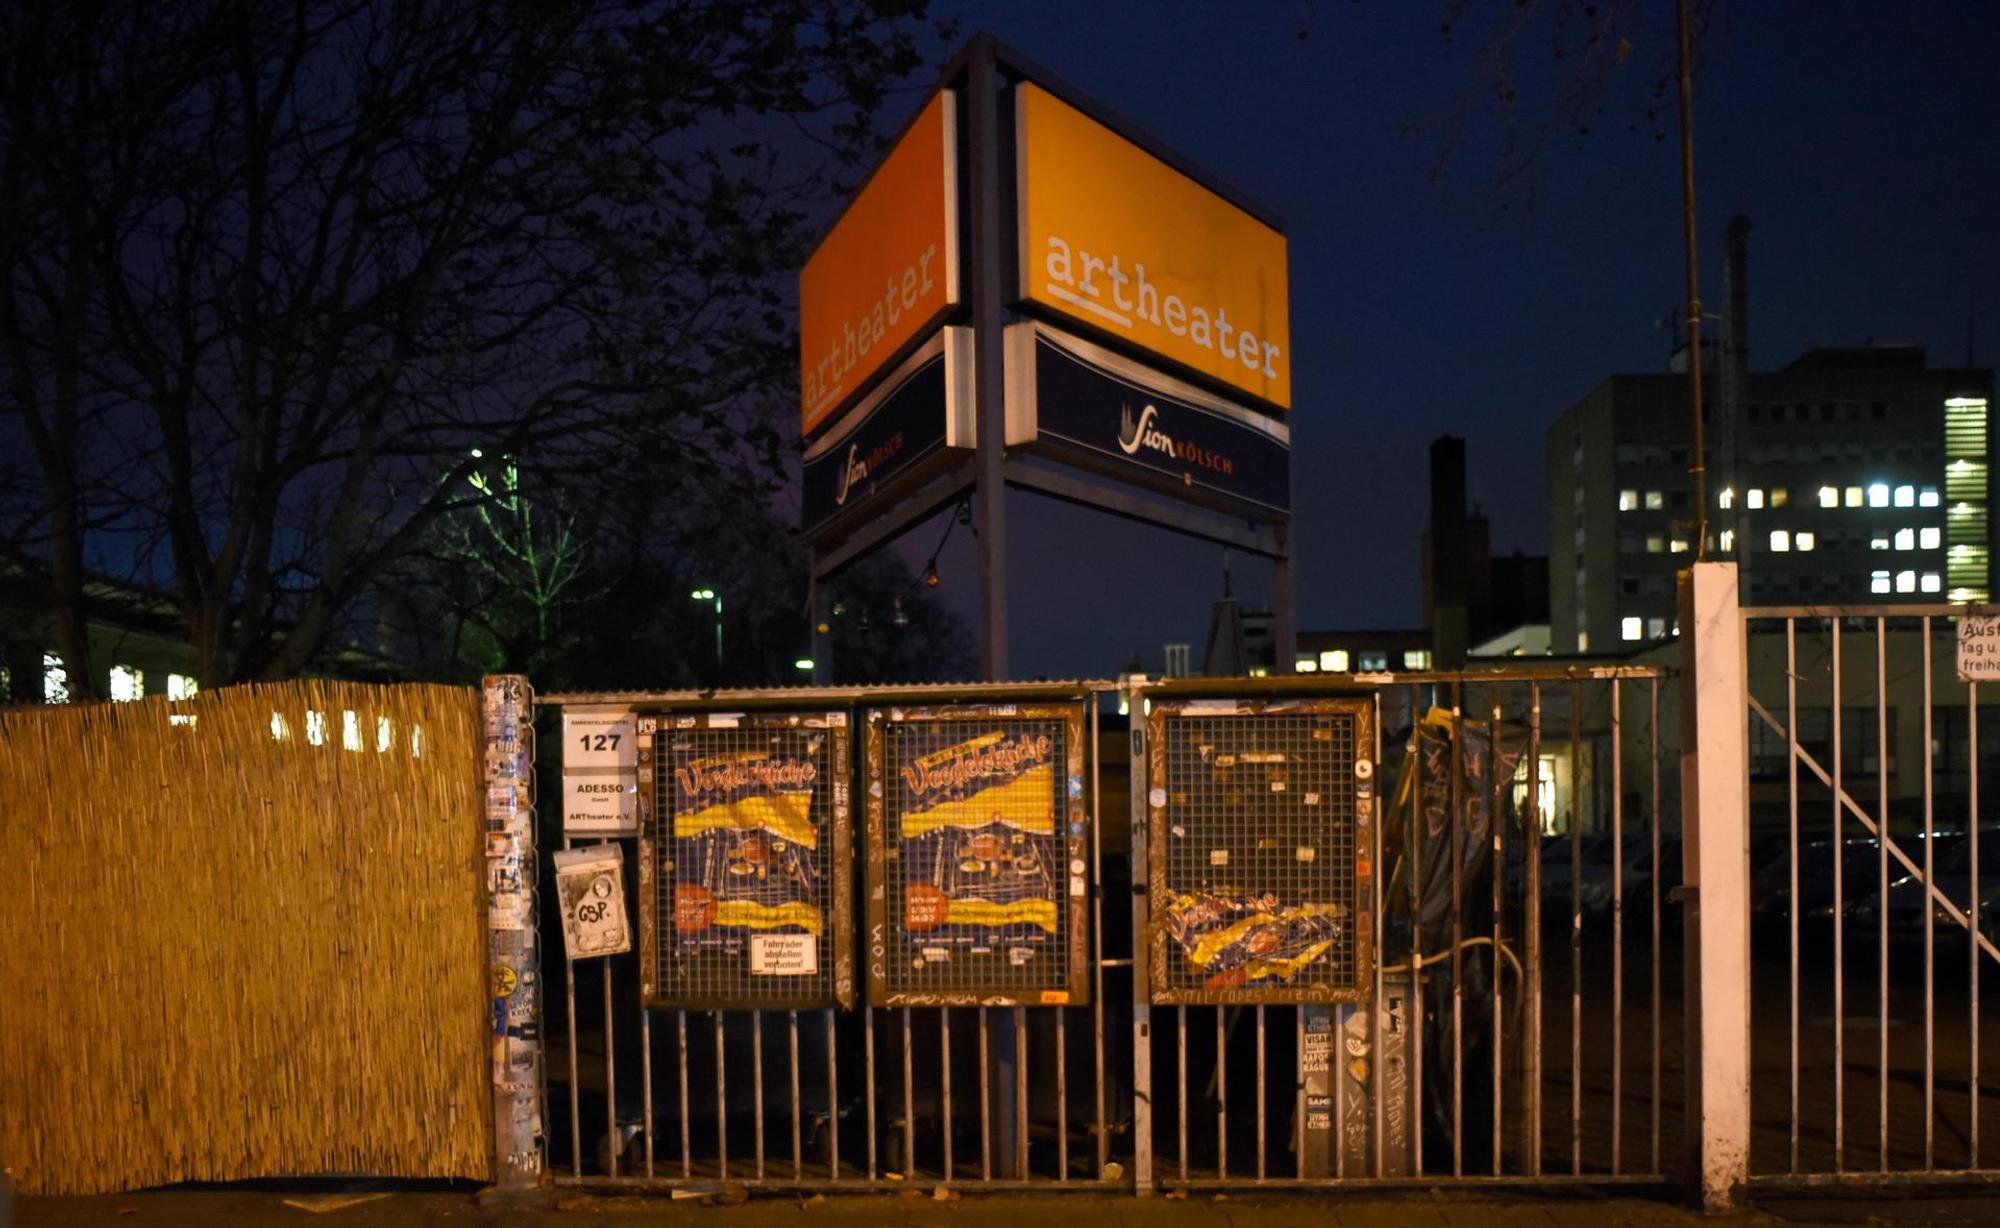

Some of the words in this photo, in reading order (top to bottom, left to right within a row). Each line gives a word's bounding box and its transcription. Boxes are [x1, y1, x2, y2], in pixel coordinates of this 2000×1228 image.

[1046, 236, 1281, 380] artheater
[806, 243, 937, 408] artheater
[1118, 404, 1177, 459] Sion
[1176, 440, 1233, 475] KÖLSCH
[1961, 641, 1983, 657] Tag
[580, 734, 622, 752] 127
[577, 784, 624, 794] ADESSO
[569, 812, 613, 821] ARTheater
